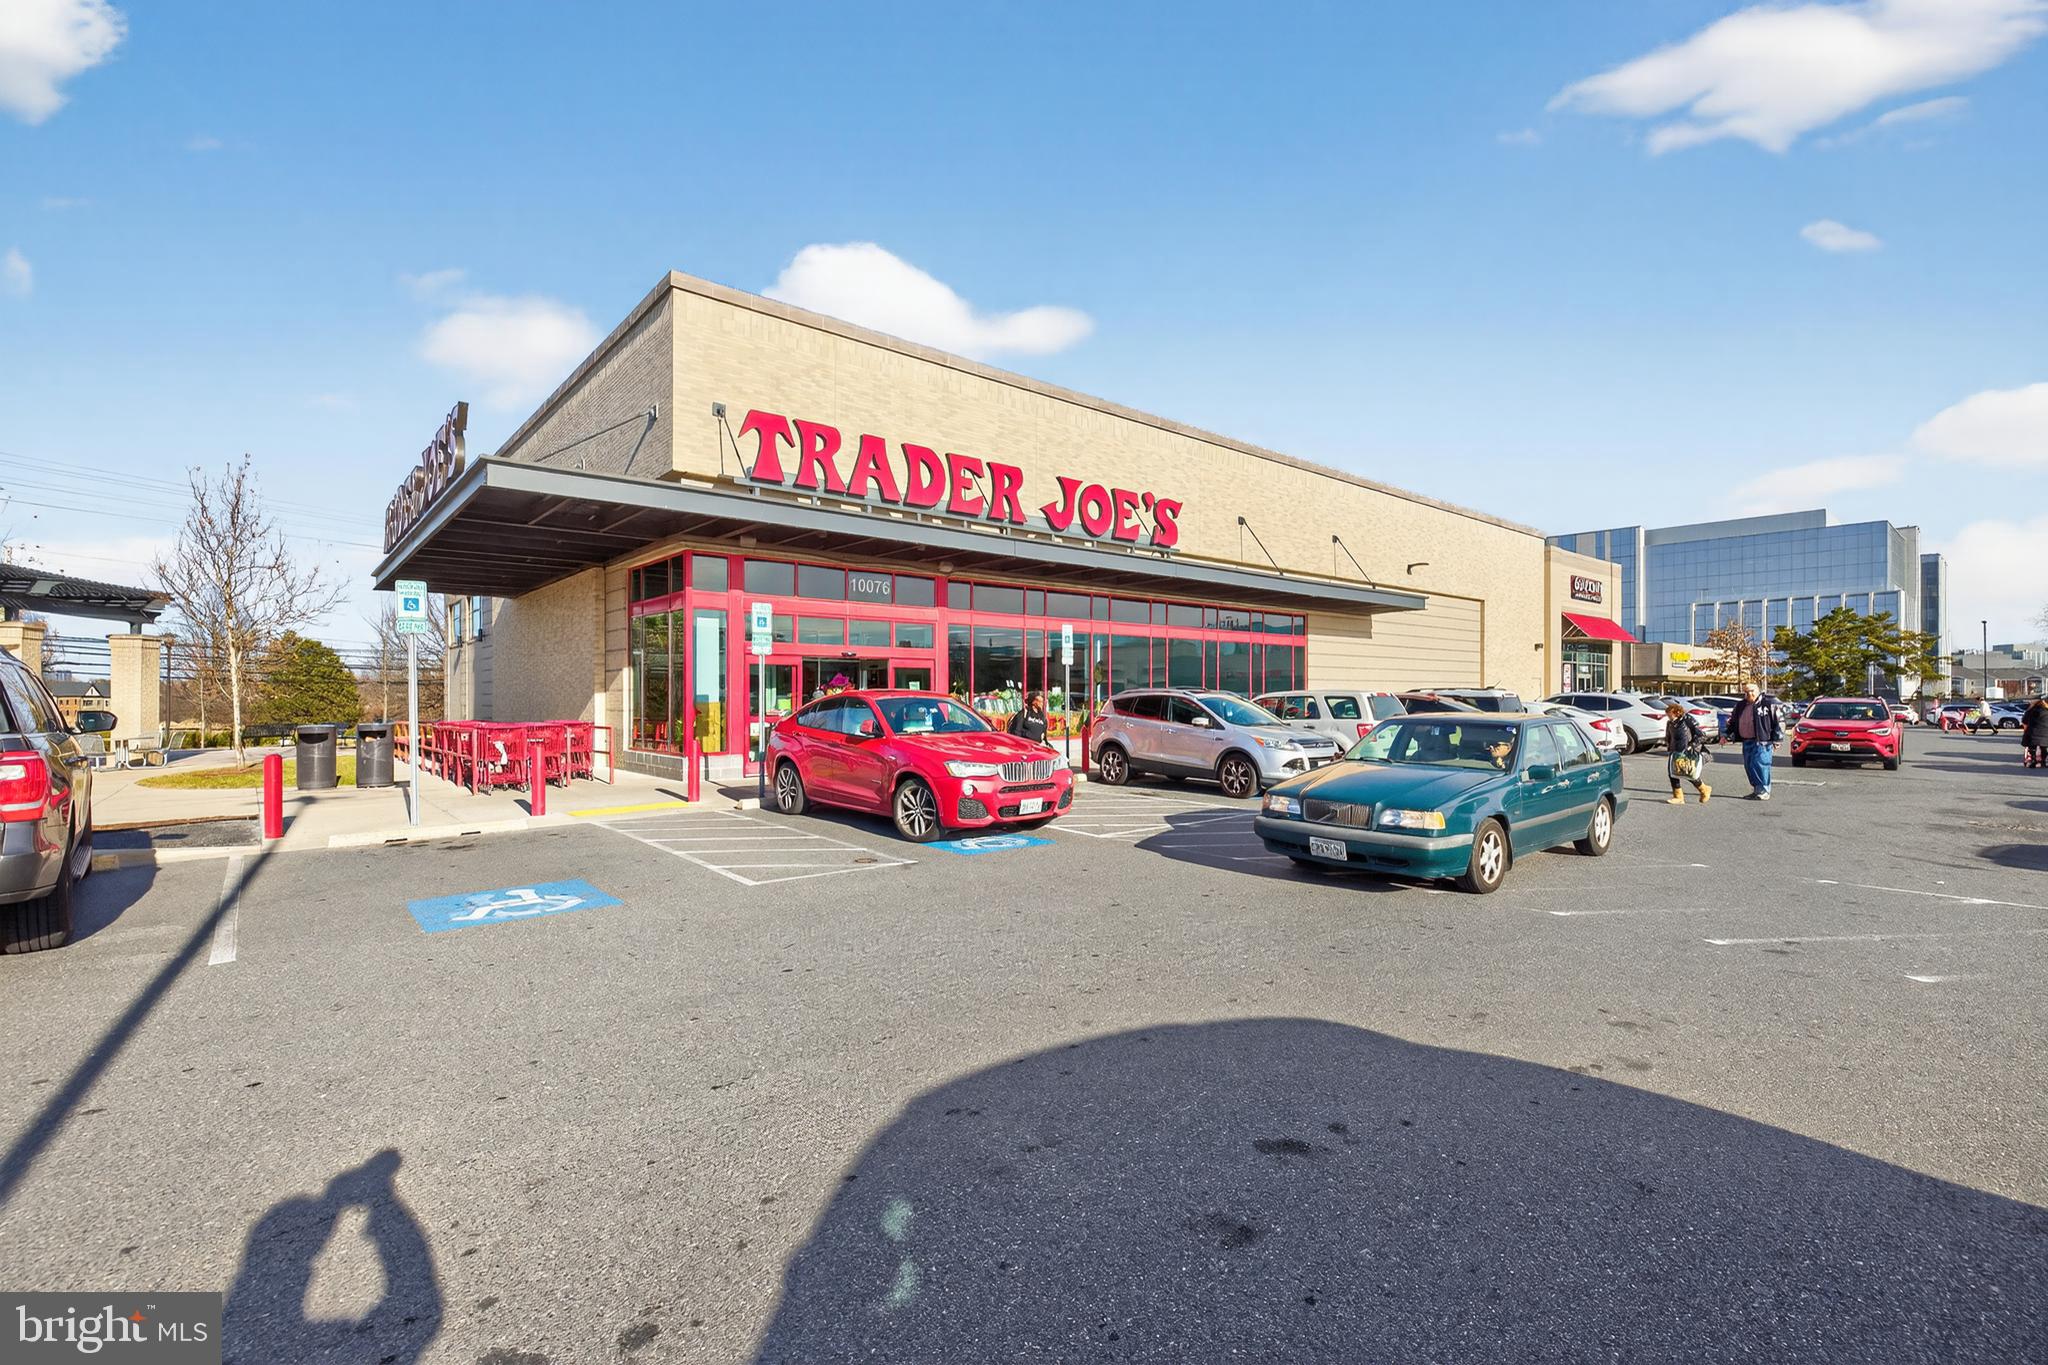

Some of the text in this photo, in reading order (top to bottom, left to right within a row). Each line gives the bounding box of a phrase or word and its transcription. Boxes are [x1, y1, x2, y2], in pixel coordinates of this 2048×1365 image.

[738, 409, 1183, 548] TRADER JOE'S
[850, 578, 890, 595] 10076
